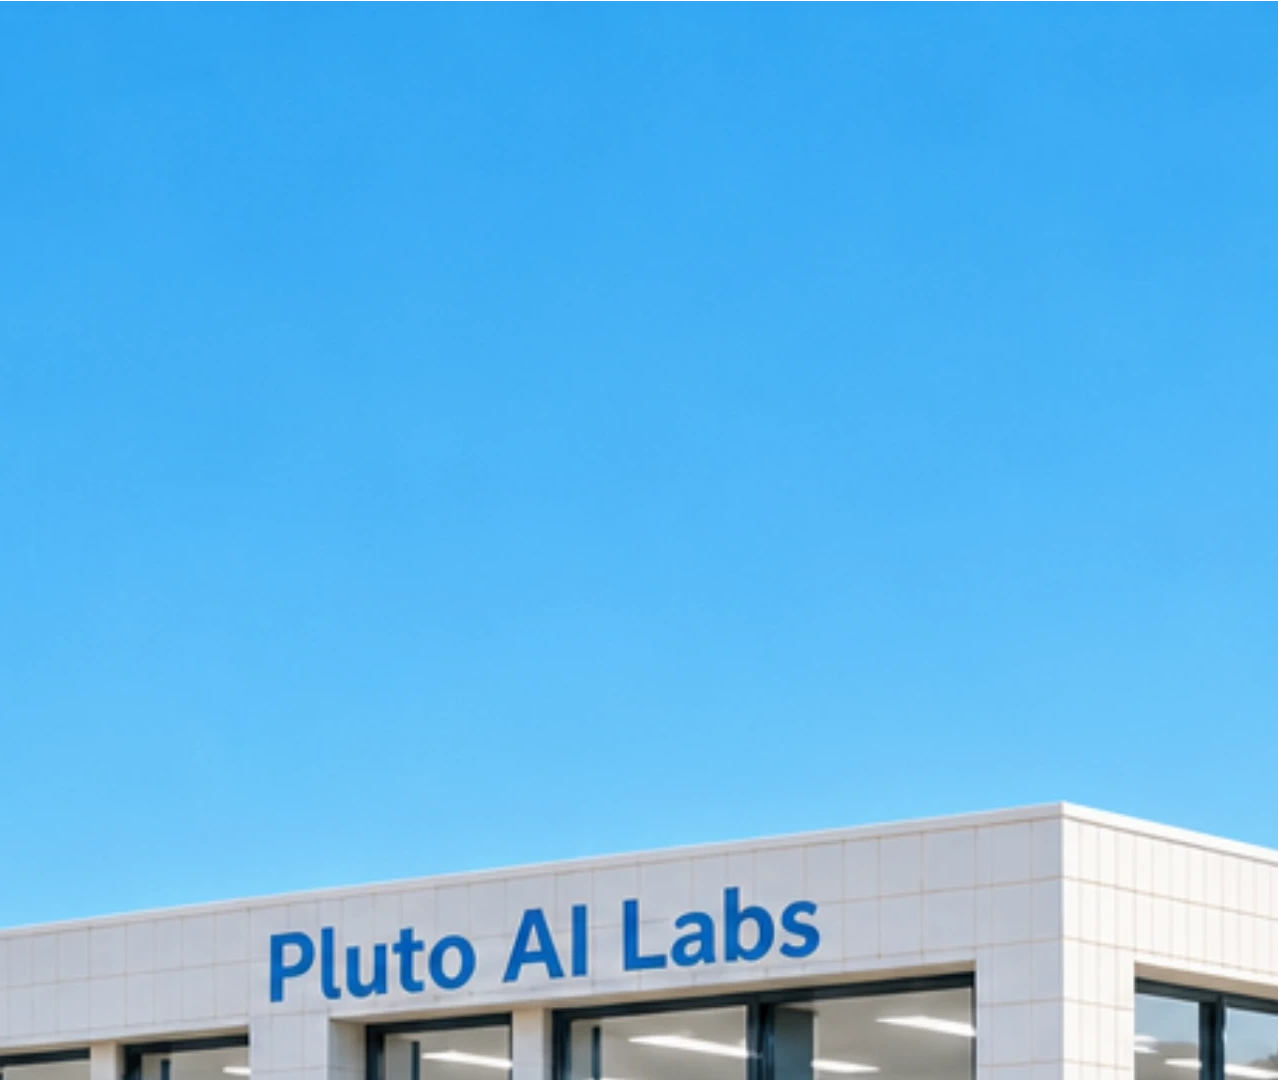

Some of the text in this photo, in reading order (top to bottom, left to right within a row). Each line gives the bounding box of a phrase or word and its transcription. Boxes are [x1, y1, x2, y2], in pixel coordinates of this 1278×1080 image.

[268, 886, 821, 1003] Pluto AI Labs
